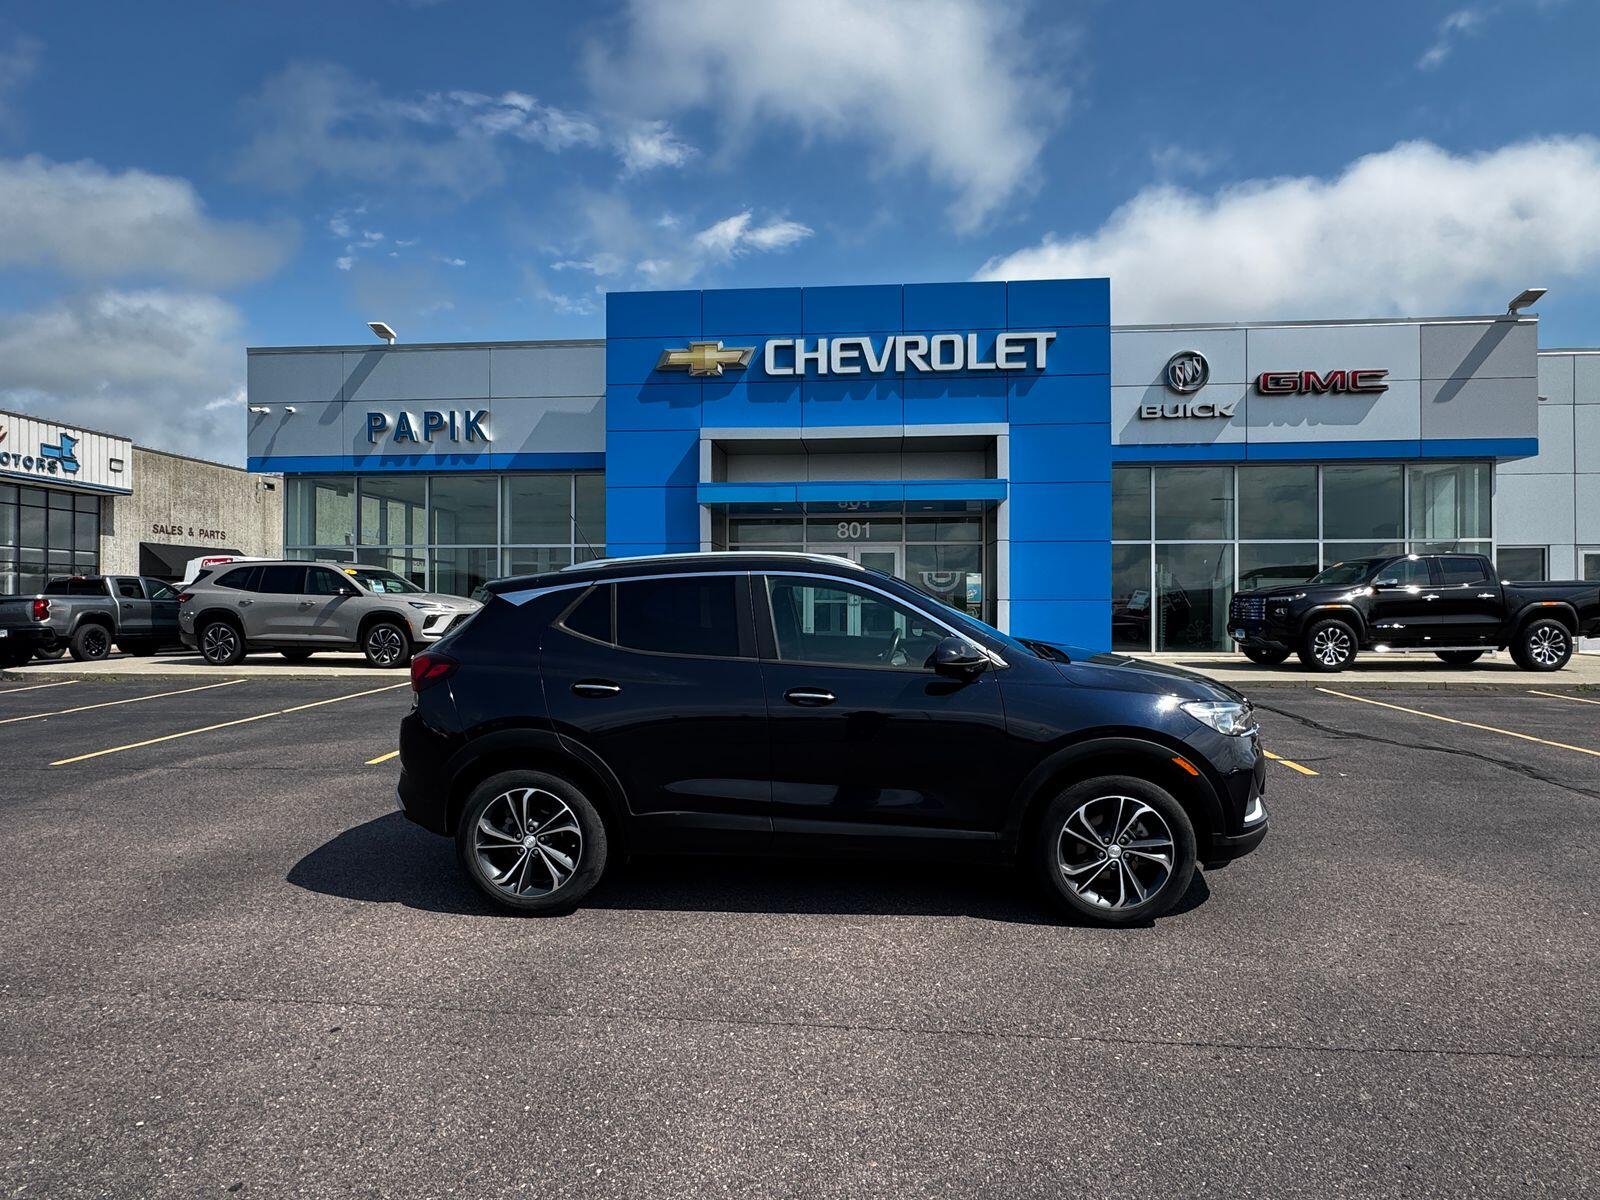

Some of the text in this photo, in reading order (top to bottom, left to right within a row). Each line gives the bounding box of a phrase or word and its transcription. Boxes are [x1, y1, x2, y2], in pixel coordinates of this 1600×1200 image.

[764, 331, 1057, 375] CHEVROLET
[1257, 369, 1389, 394] GMC
[1140, 402, 1235, 420] BUICK
[367, 410, 491, 443] PAPIK
[152, 523, 227, 540] SALES & PARTS
[837, 521, 870, 539] 801
